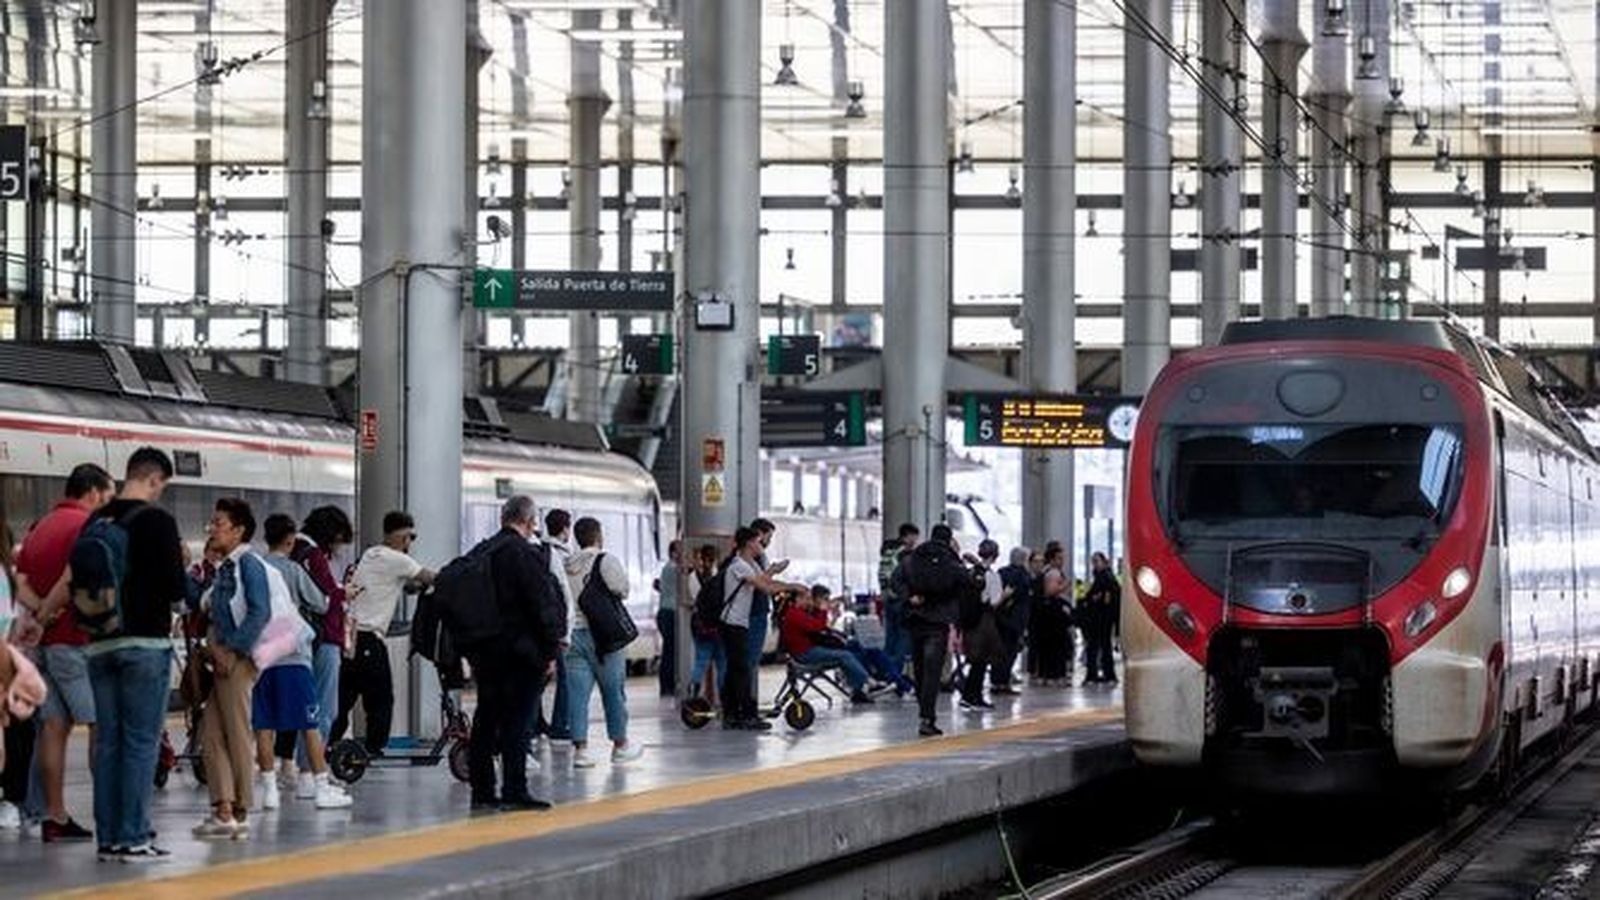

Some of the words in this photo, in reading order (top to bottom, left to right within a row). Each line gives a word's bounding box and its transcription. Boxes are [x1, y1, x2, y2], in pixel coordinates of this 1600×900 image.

[2, 162, 20, 195] 5
[521, 278, 560, 290] Salida
[563, 278, 606, 291] Puerta
[609, 279, 627, 291] de
[630, 279, 666, 291] Tierra
[624, 353, 638, 372] 4
[804, 354, 817, 374] 5
[834, 419, 847, 438] 4
[980, 419, 993, 439] 5
